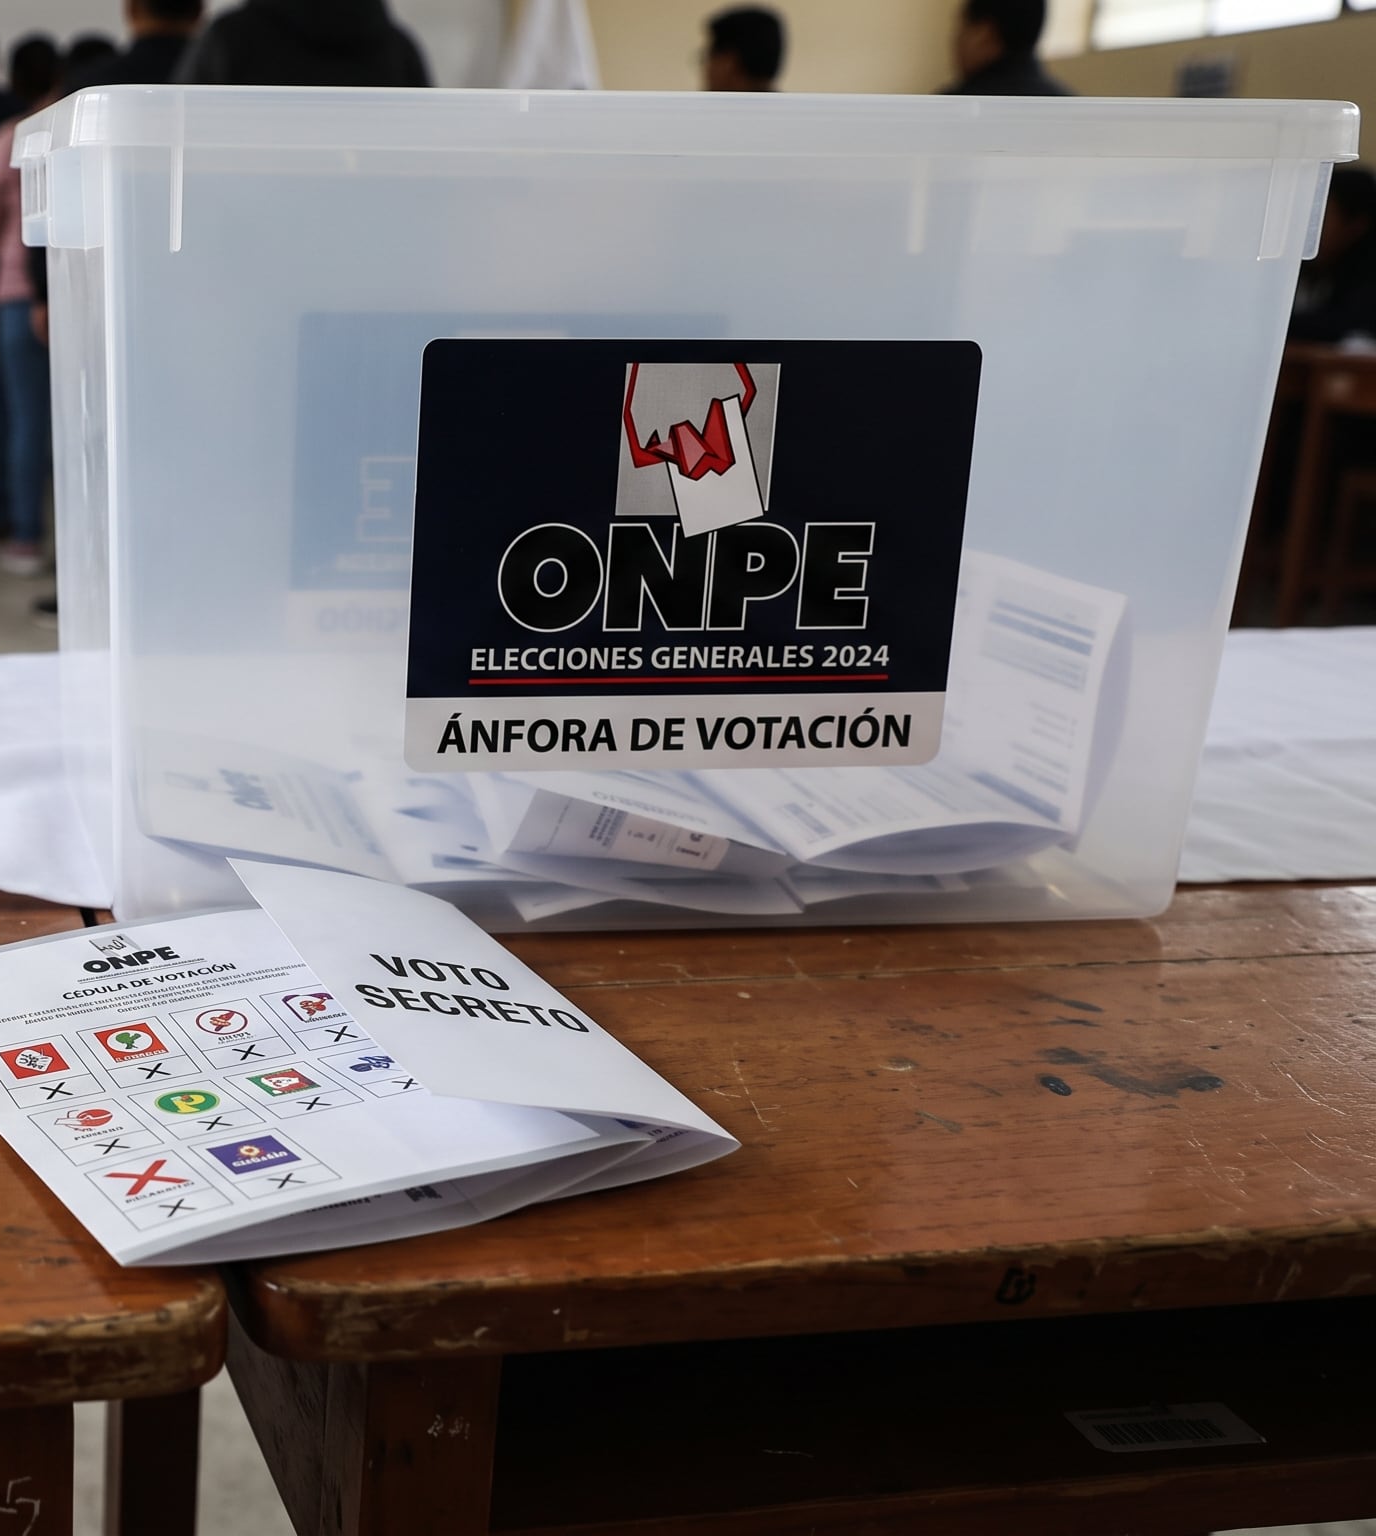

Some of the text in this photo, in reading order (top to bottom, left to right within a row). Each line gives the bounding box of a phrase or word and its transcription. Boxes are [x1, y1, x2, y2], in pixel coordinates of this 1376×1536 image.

[497, 521, 876, 632] ONPE
[470, 644, 890, 671] ELECCIONES GENERALES 2024
[436, 707, 913, 754] ÁNFORA DE VOTACIÓN
[82, 946, 181, 974] ONPE
[368, 953, 510, 991] VOTO
[62, 981, 129, 1001] CÉDULA
[130, 977, 156, 990] DE
[156, 962, 237, 984] VOTACIÓN
[354, 984, 590, 1033] SECRETO
